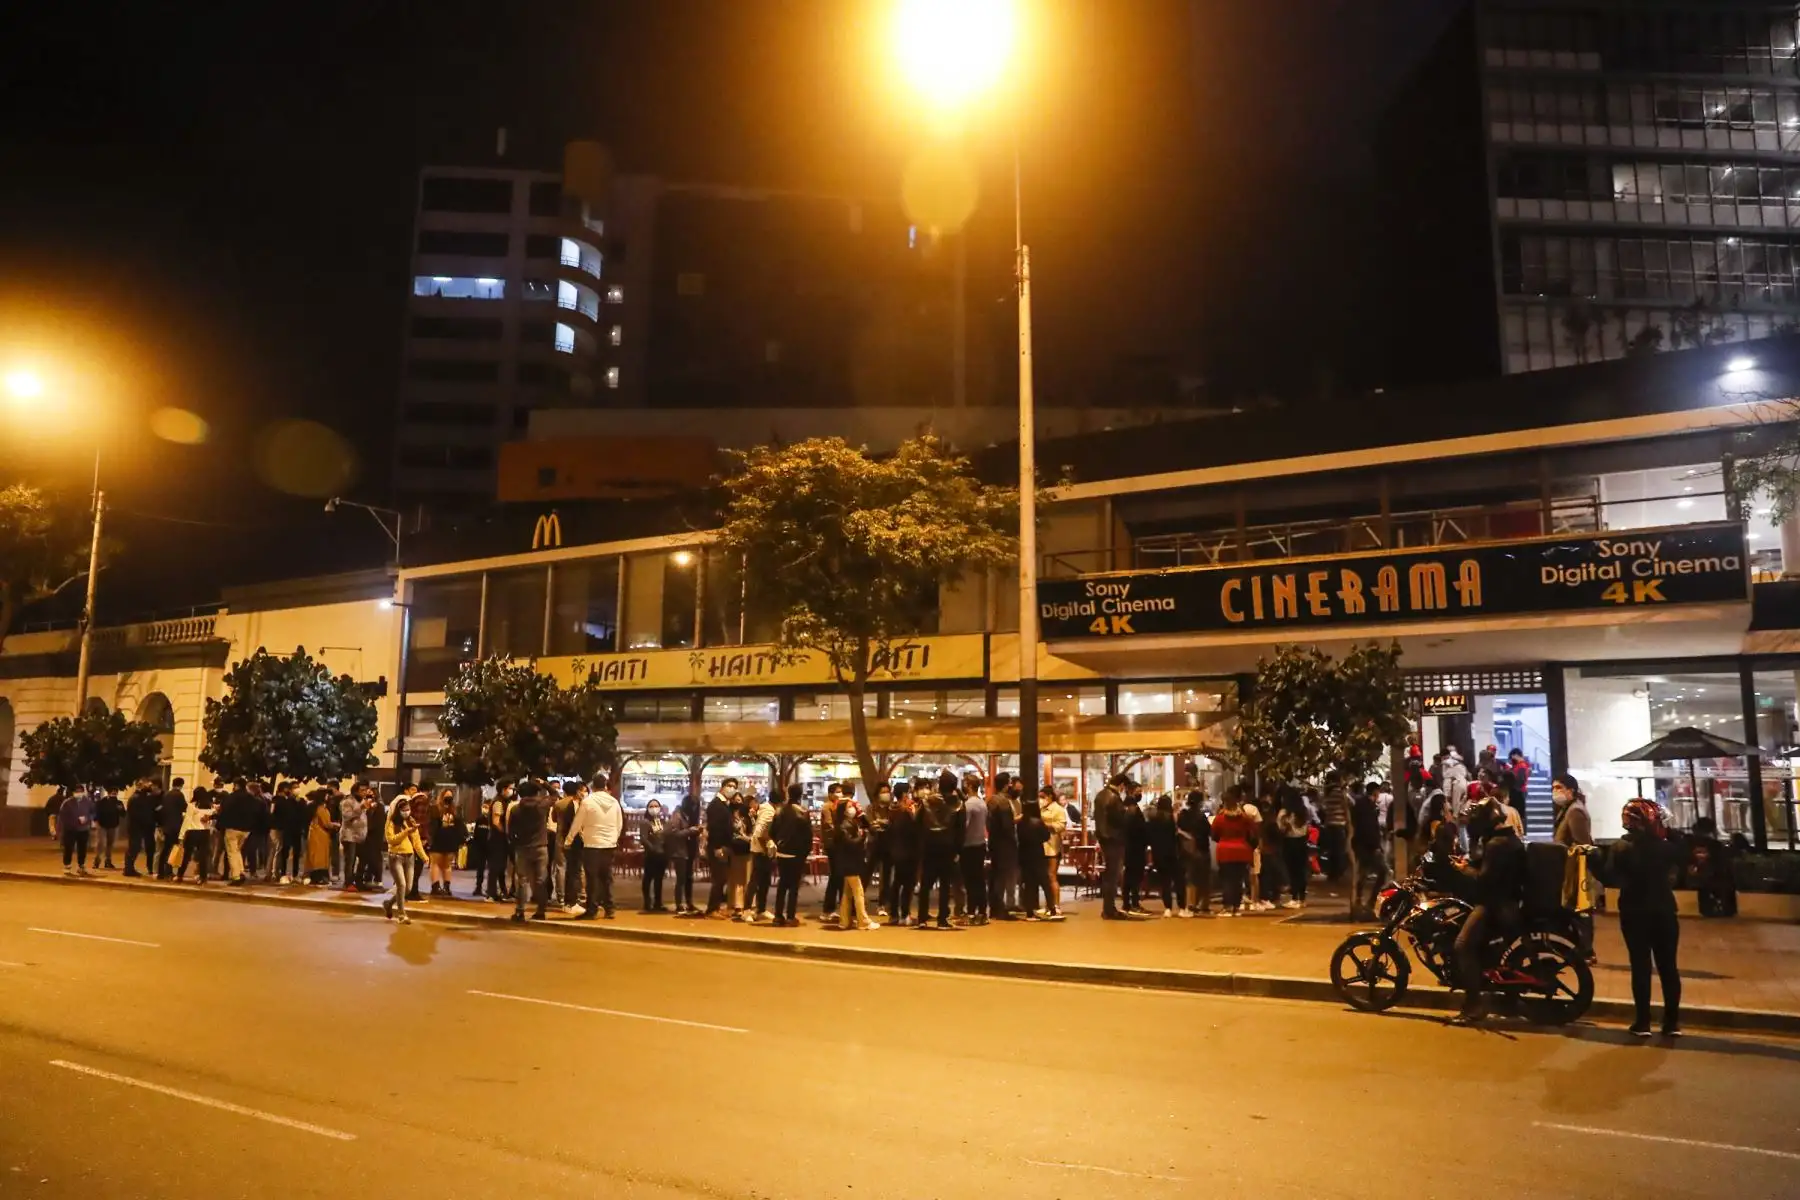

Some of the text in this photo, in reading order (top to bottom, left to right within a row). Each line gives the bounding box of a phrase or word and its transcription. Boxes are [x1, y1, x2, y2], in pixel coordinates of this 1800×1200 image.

[1598, 539, 1662, 559] Sony
[1541, 555, 1740, 587] Digital Cinema
[1085, 582, 1131, 599] Sony
[1220, 559, 1482, 622] CINERAMA
[1602, 579, 1667, 604] 4K
[1041, 598, 1176, 621] Digital Cinema
[1089, 614, 1136, 635] 4K
[588, 659, 648, 681] HAITI
[708, 653, 779, 678] HAITI
[868, 645, 930, 672] AITI
[1424, 694, 1465, 707] HAITI
